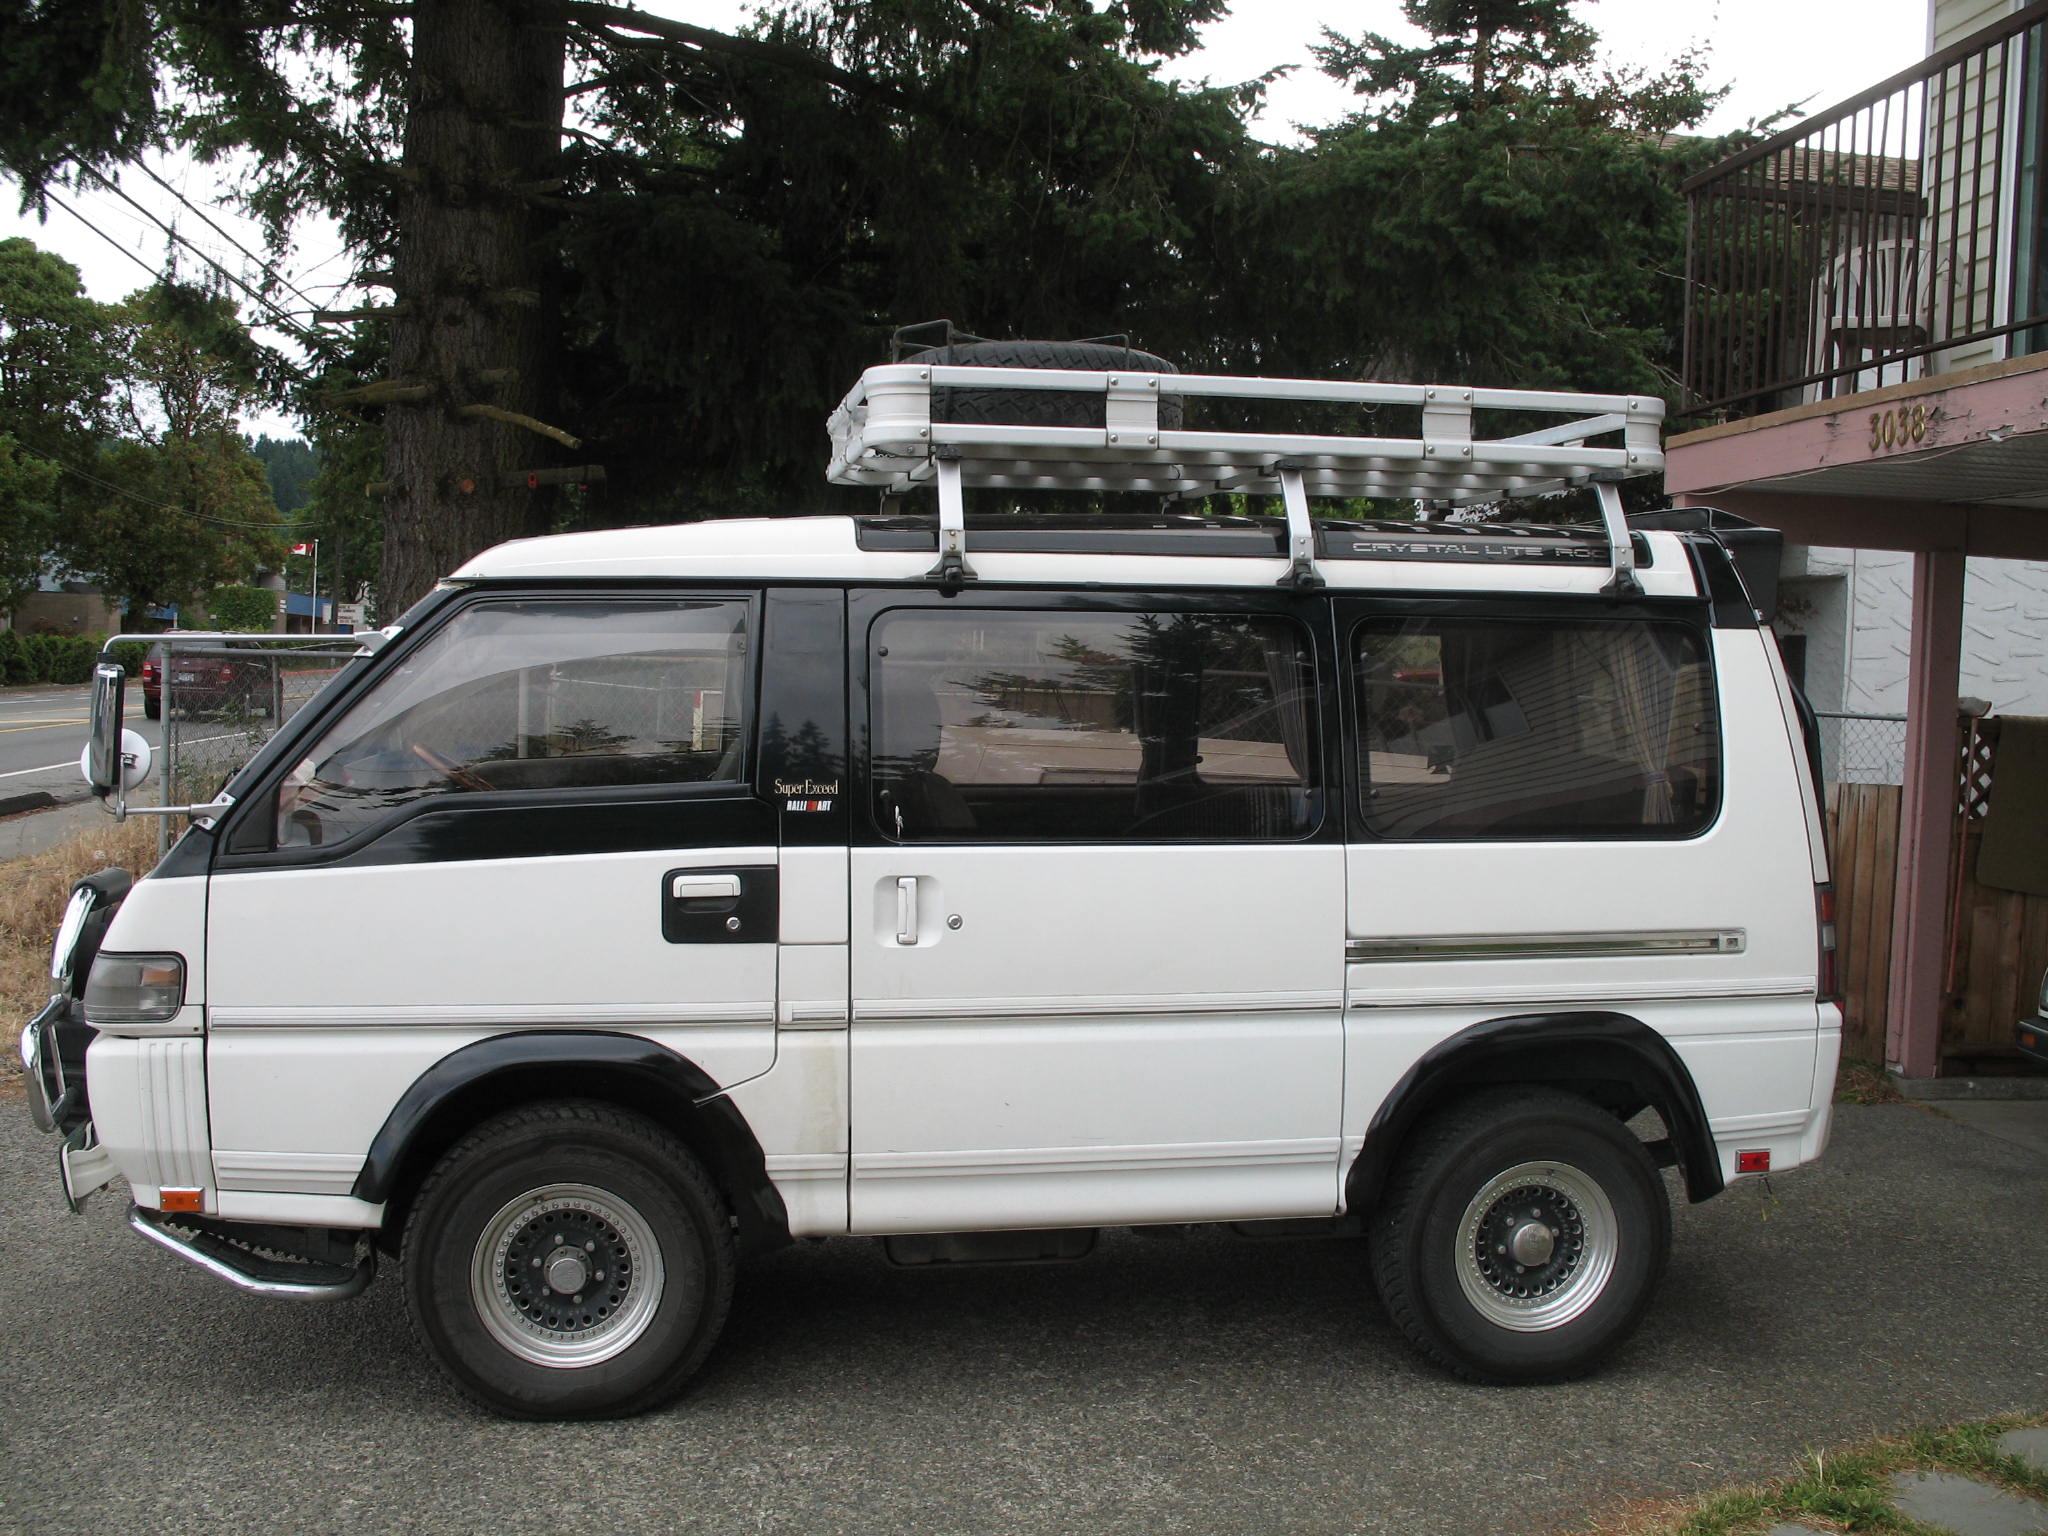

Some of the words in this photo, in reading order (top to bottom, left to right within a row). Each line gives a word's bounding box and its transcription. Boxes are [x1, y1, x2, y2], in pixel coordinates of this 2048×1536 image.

[1868, 404, 1926, 452] 3038
[1352, 542, 1479, 554] CRYSTAL
[1484, 545, 1544, 556] LITE
[774, 778, 804, 797] Super
[805, 779, 838, 795] Exceed
